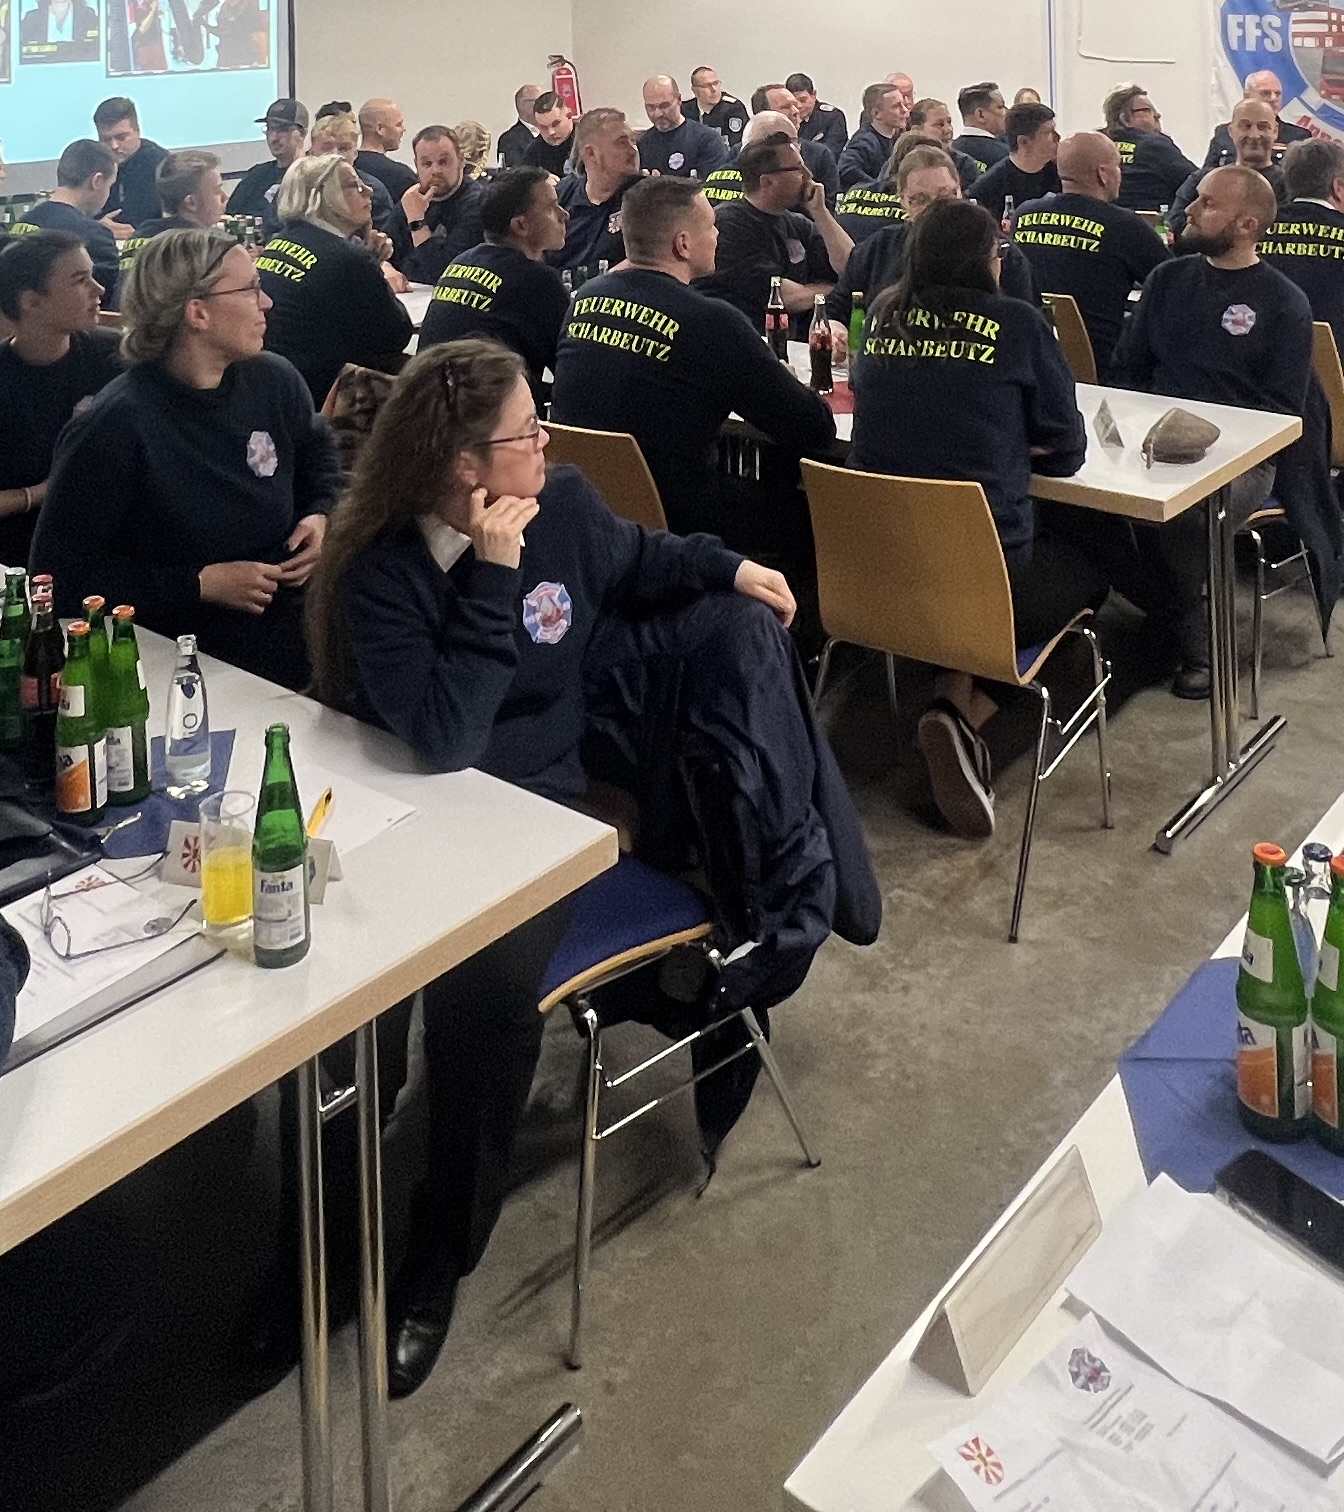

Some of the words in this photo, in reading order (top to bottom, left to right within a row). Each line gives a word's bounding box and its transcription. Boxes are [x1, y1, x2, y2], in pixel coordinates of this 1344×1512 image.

[1226, 13, 1283, 53] FFS
[1013, 230, 1101, 254] SCHARBEUTZ
[1016, 211, 1106, 239] FEUERWEHR
[572, 295, 681, 341] FEUERWEHR
[566, 321, 673, 363] SCHARBEUTZ
[260, 879, 294, 894] Fanta
